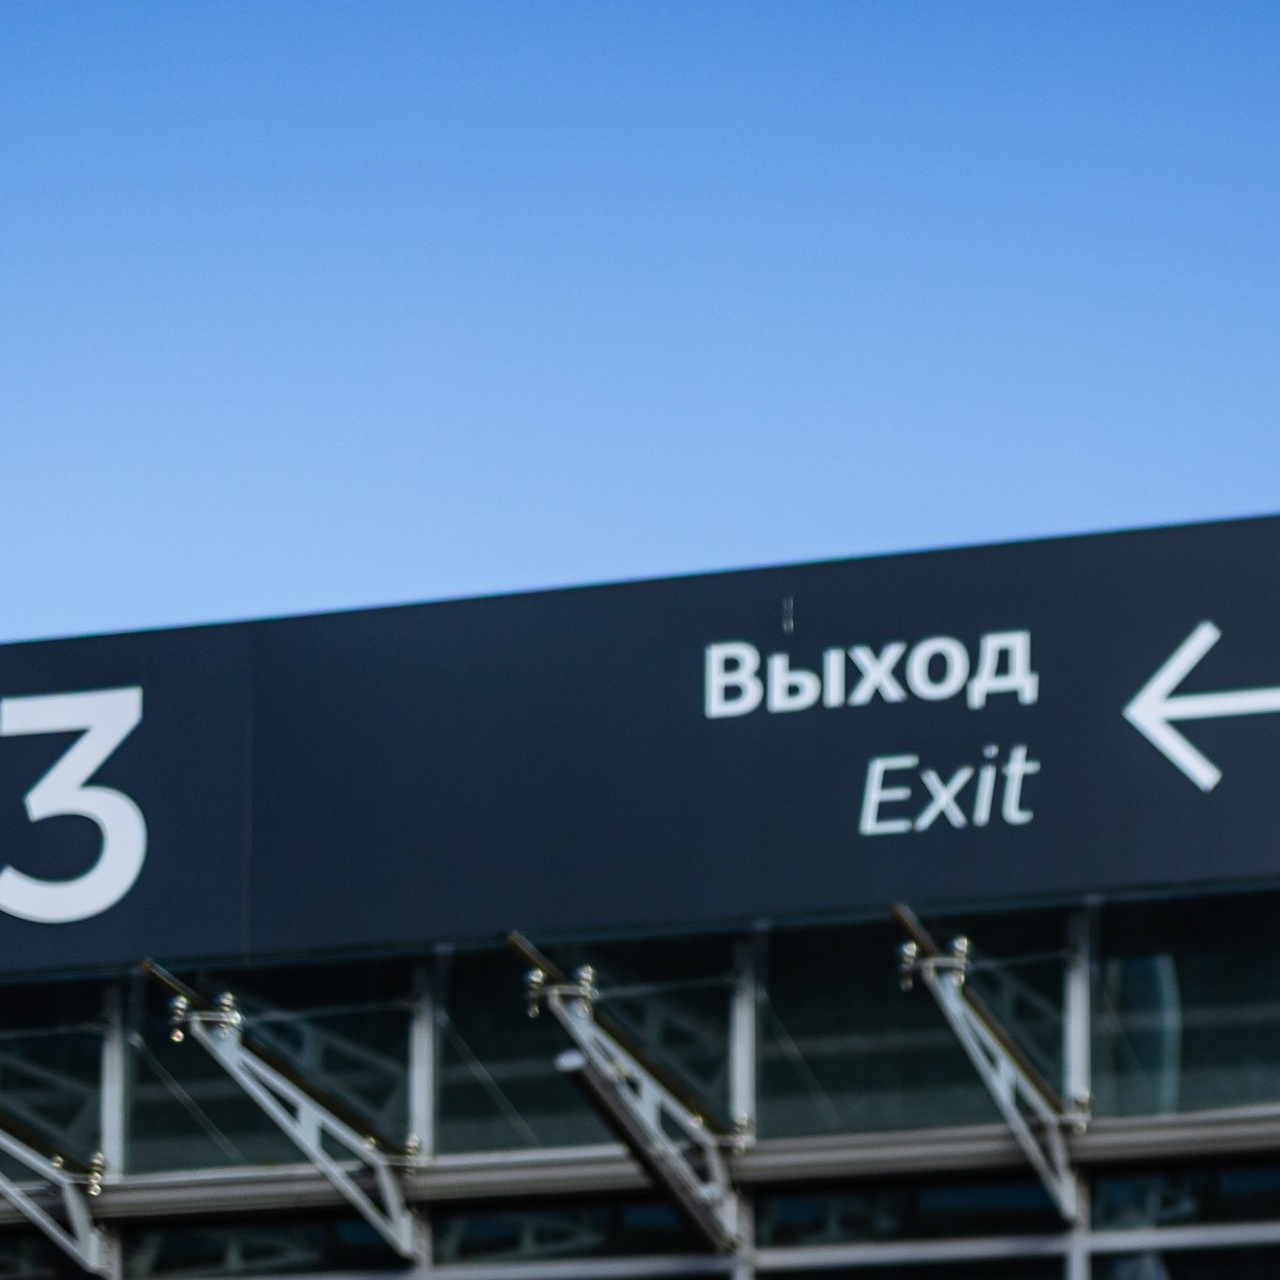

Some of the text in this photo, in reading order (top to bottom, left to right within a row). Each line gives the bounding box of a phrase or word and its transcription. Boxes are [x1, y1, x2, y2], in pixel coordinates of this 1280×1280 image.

[704, 630, 1039, 719] Выход
[0, 684, 148, 925] 3
[859, 743, 1041, 837] Exit
